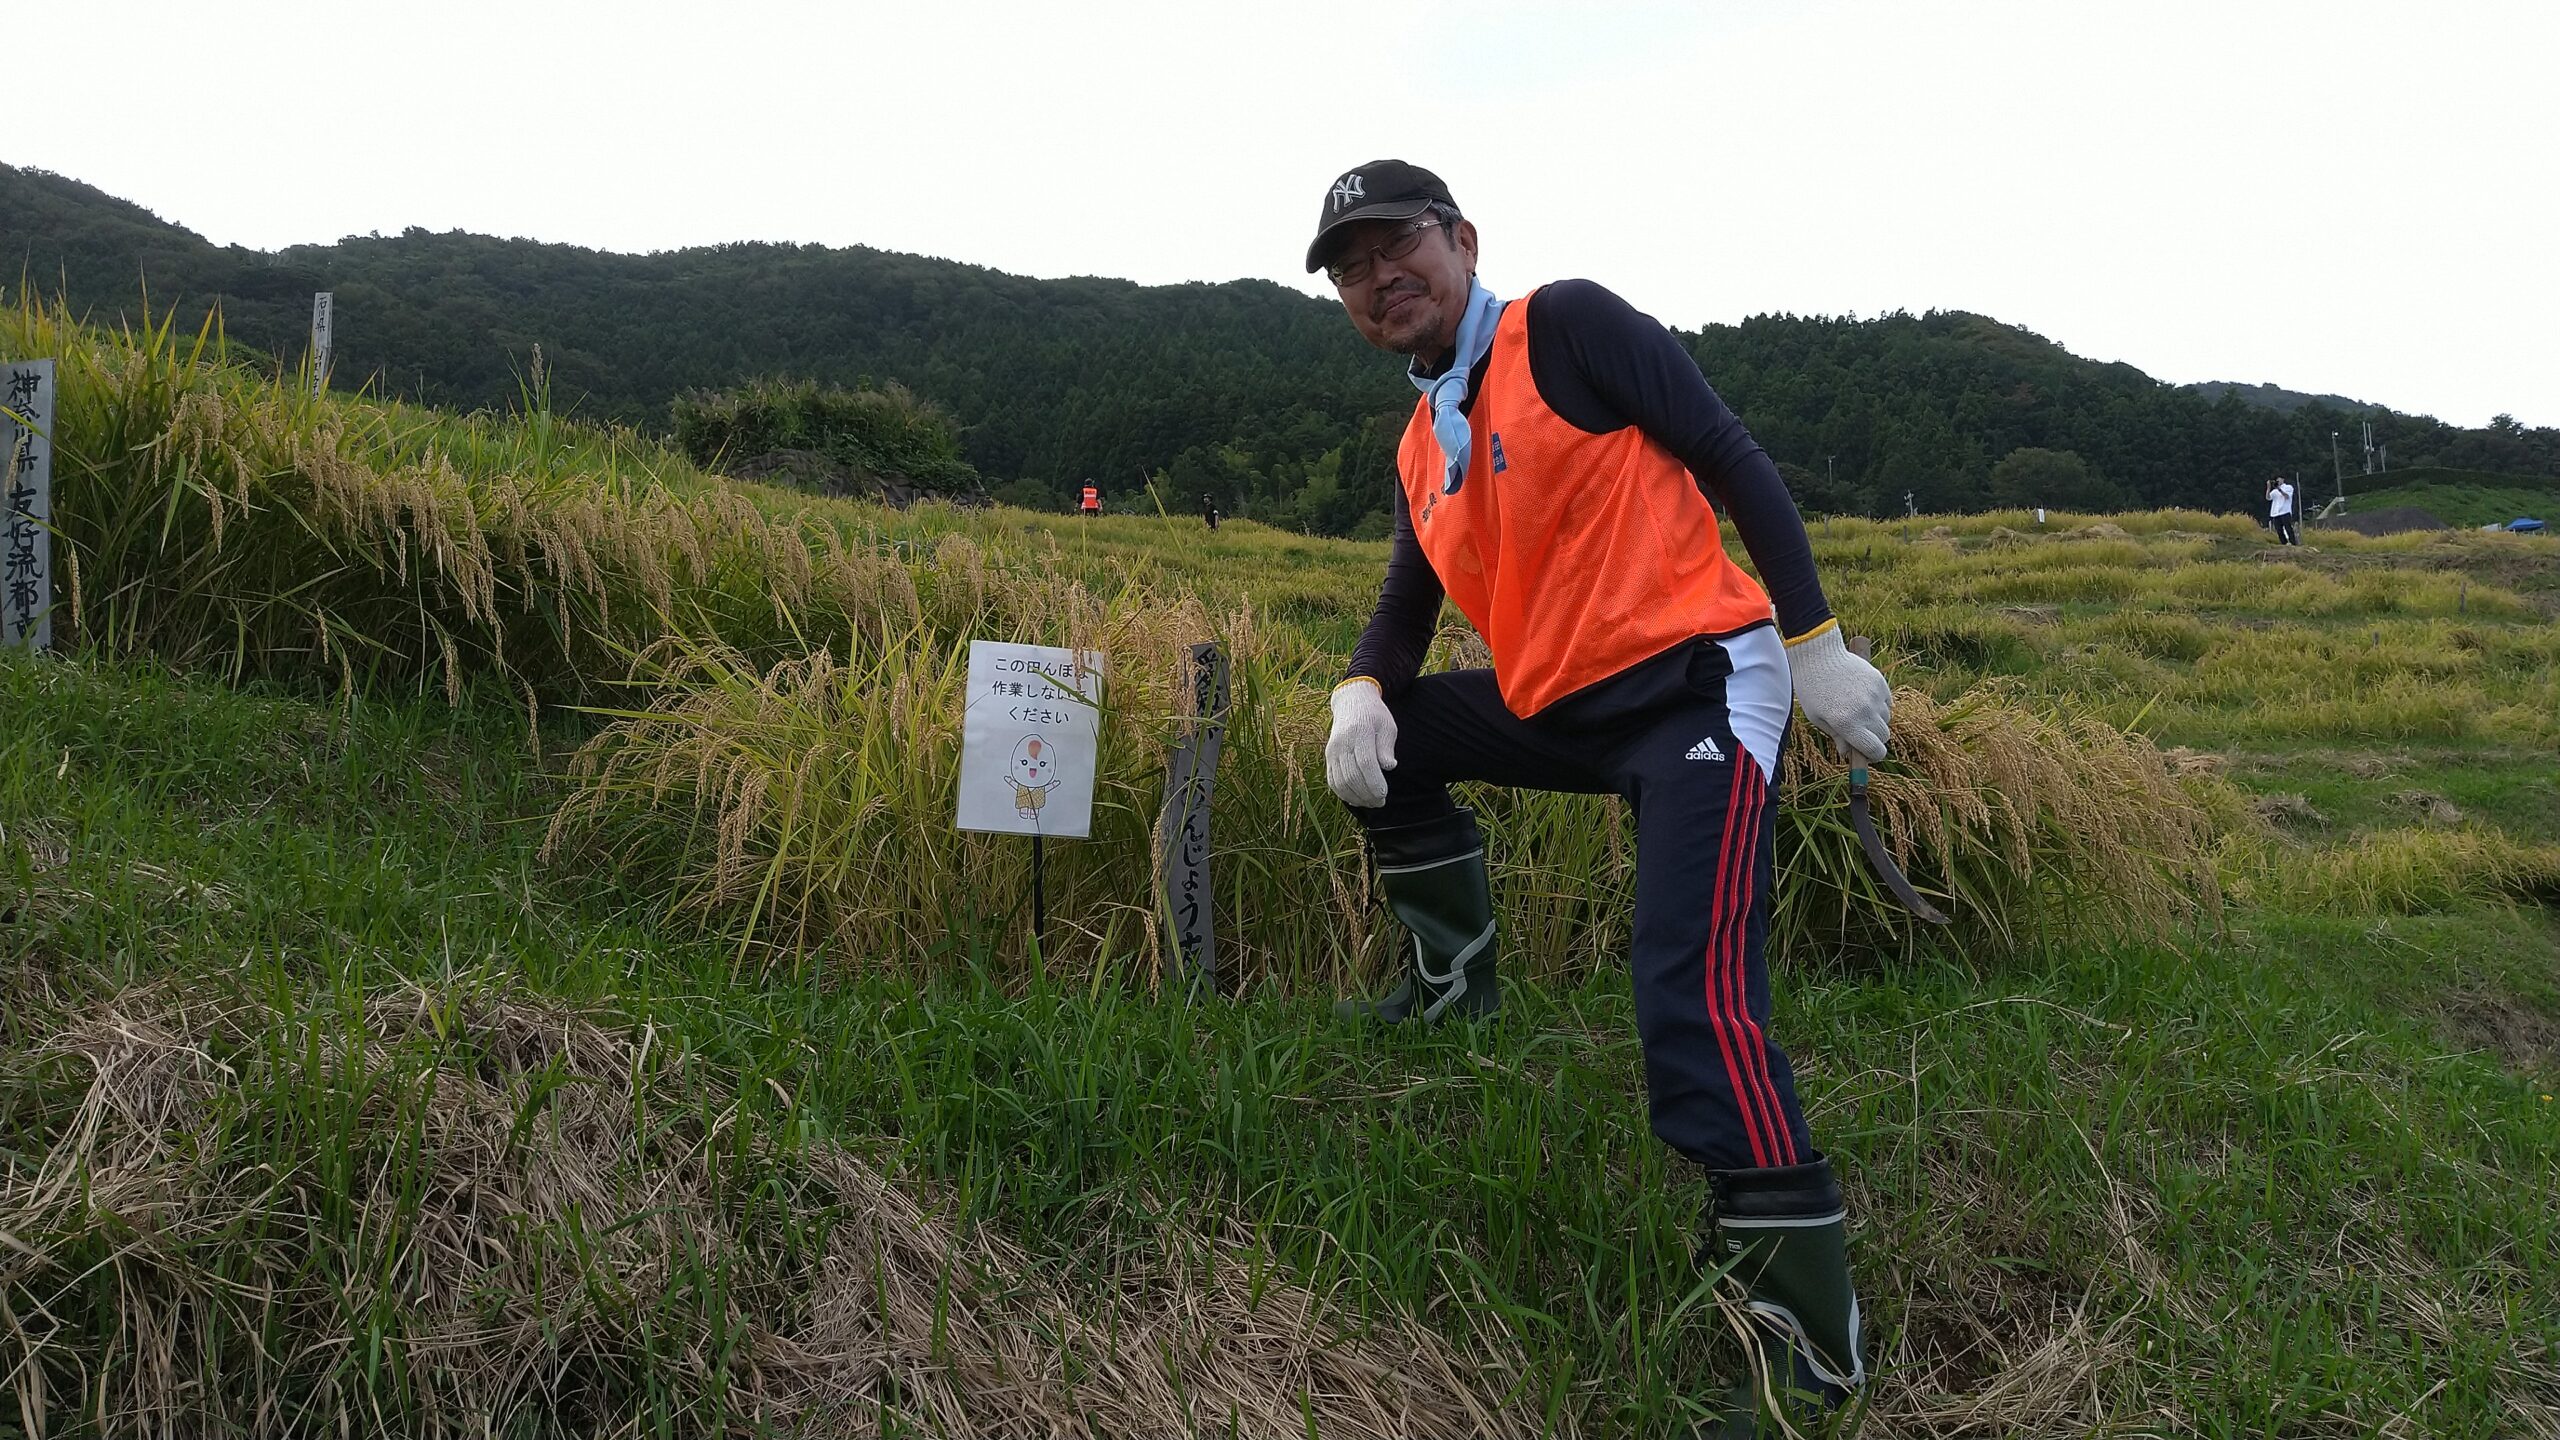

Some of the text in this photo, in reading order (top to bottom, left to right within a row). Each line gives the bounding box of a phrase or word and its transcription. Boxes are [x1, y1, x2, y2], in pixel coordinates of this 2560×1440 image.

[1332, 174, 1366, 214] NY
[314, 296, 328, 333] 石川県
[1008, 706, 1070, 725] ください
[1685, 751, 1725, 761] adidas
